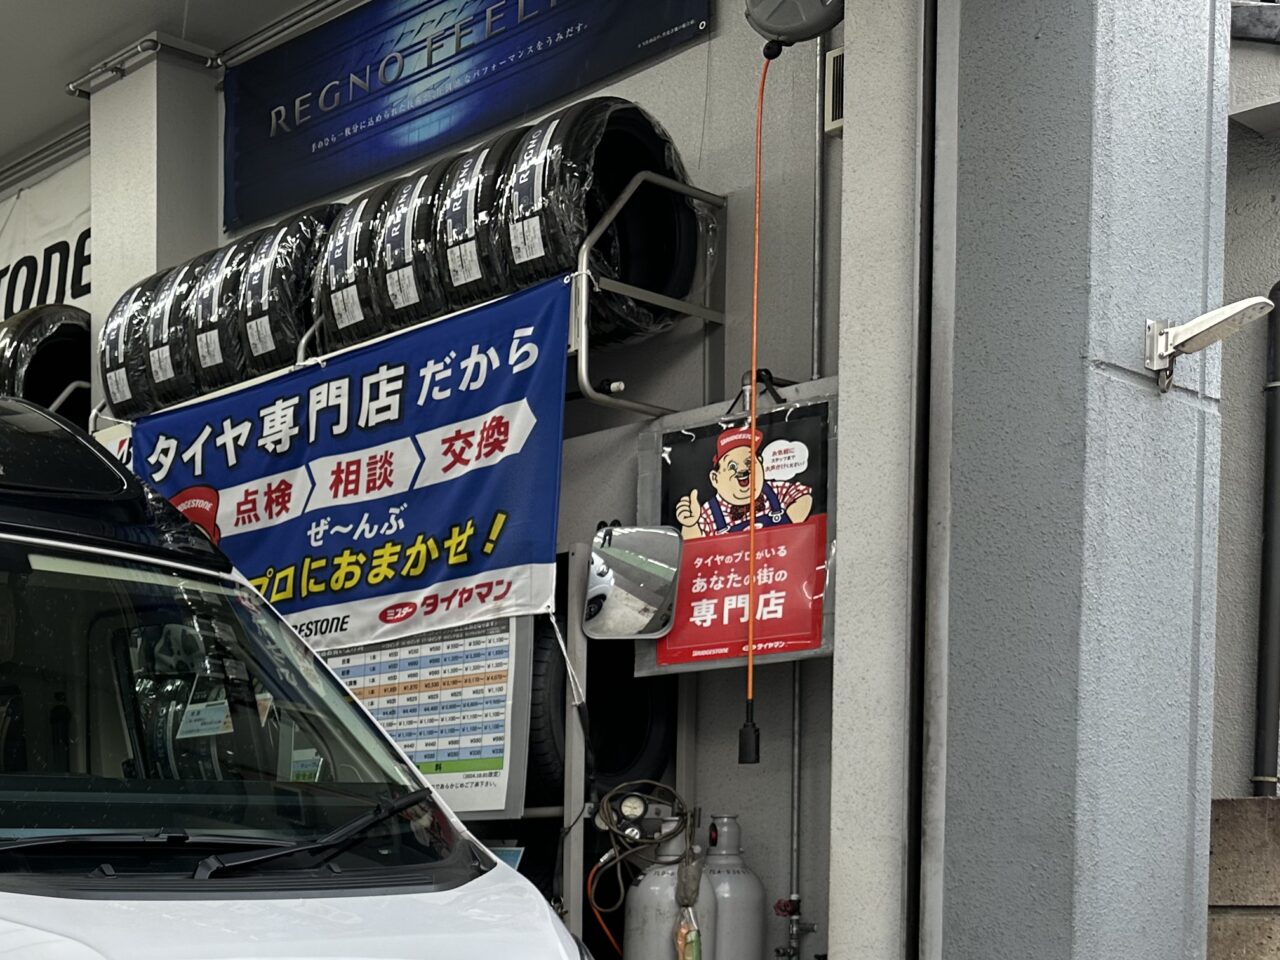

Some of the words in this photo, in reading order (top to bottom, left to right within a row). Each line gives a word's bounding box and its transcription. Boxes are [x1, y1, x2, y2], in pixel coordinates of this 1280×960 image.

[270, 52, 405, 137] REGNO
[426, 0, 558, 67] FEEL
[233, 479, 293, 527] 点検
[329, 450, 394, 499] 相談
[441, 414, 510, 473] 交換
[694, 545, 787, 569] タイヤのプロがいる
[420, 578, 513, 616] タイヤマン
[689, 590, 786, 628] 専門店
